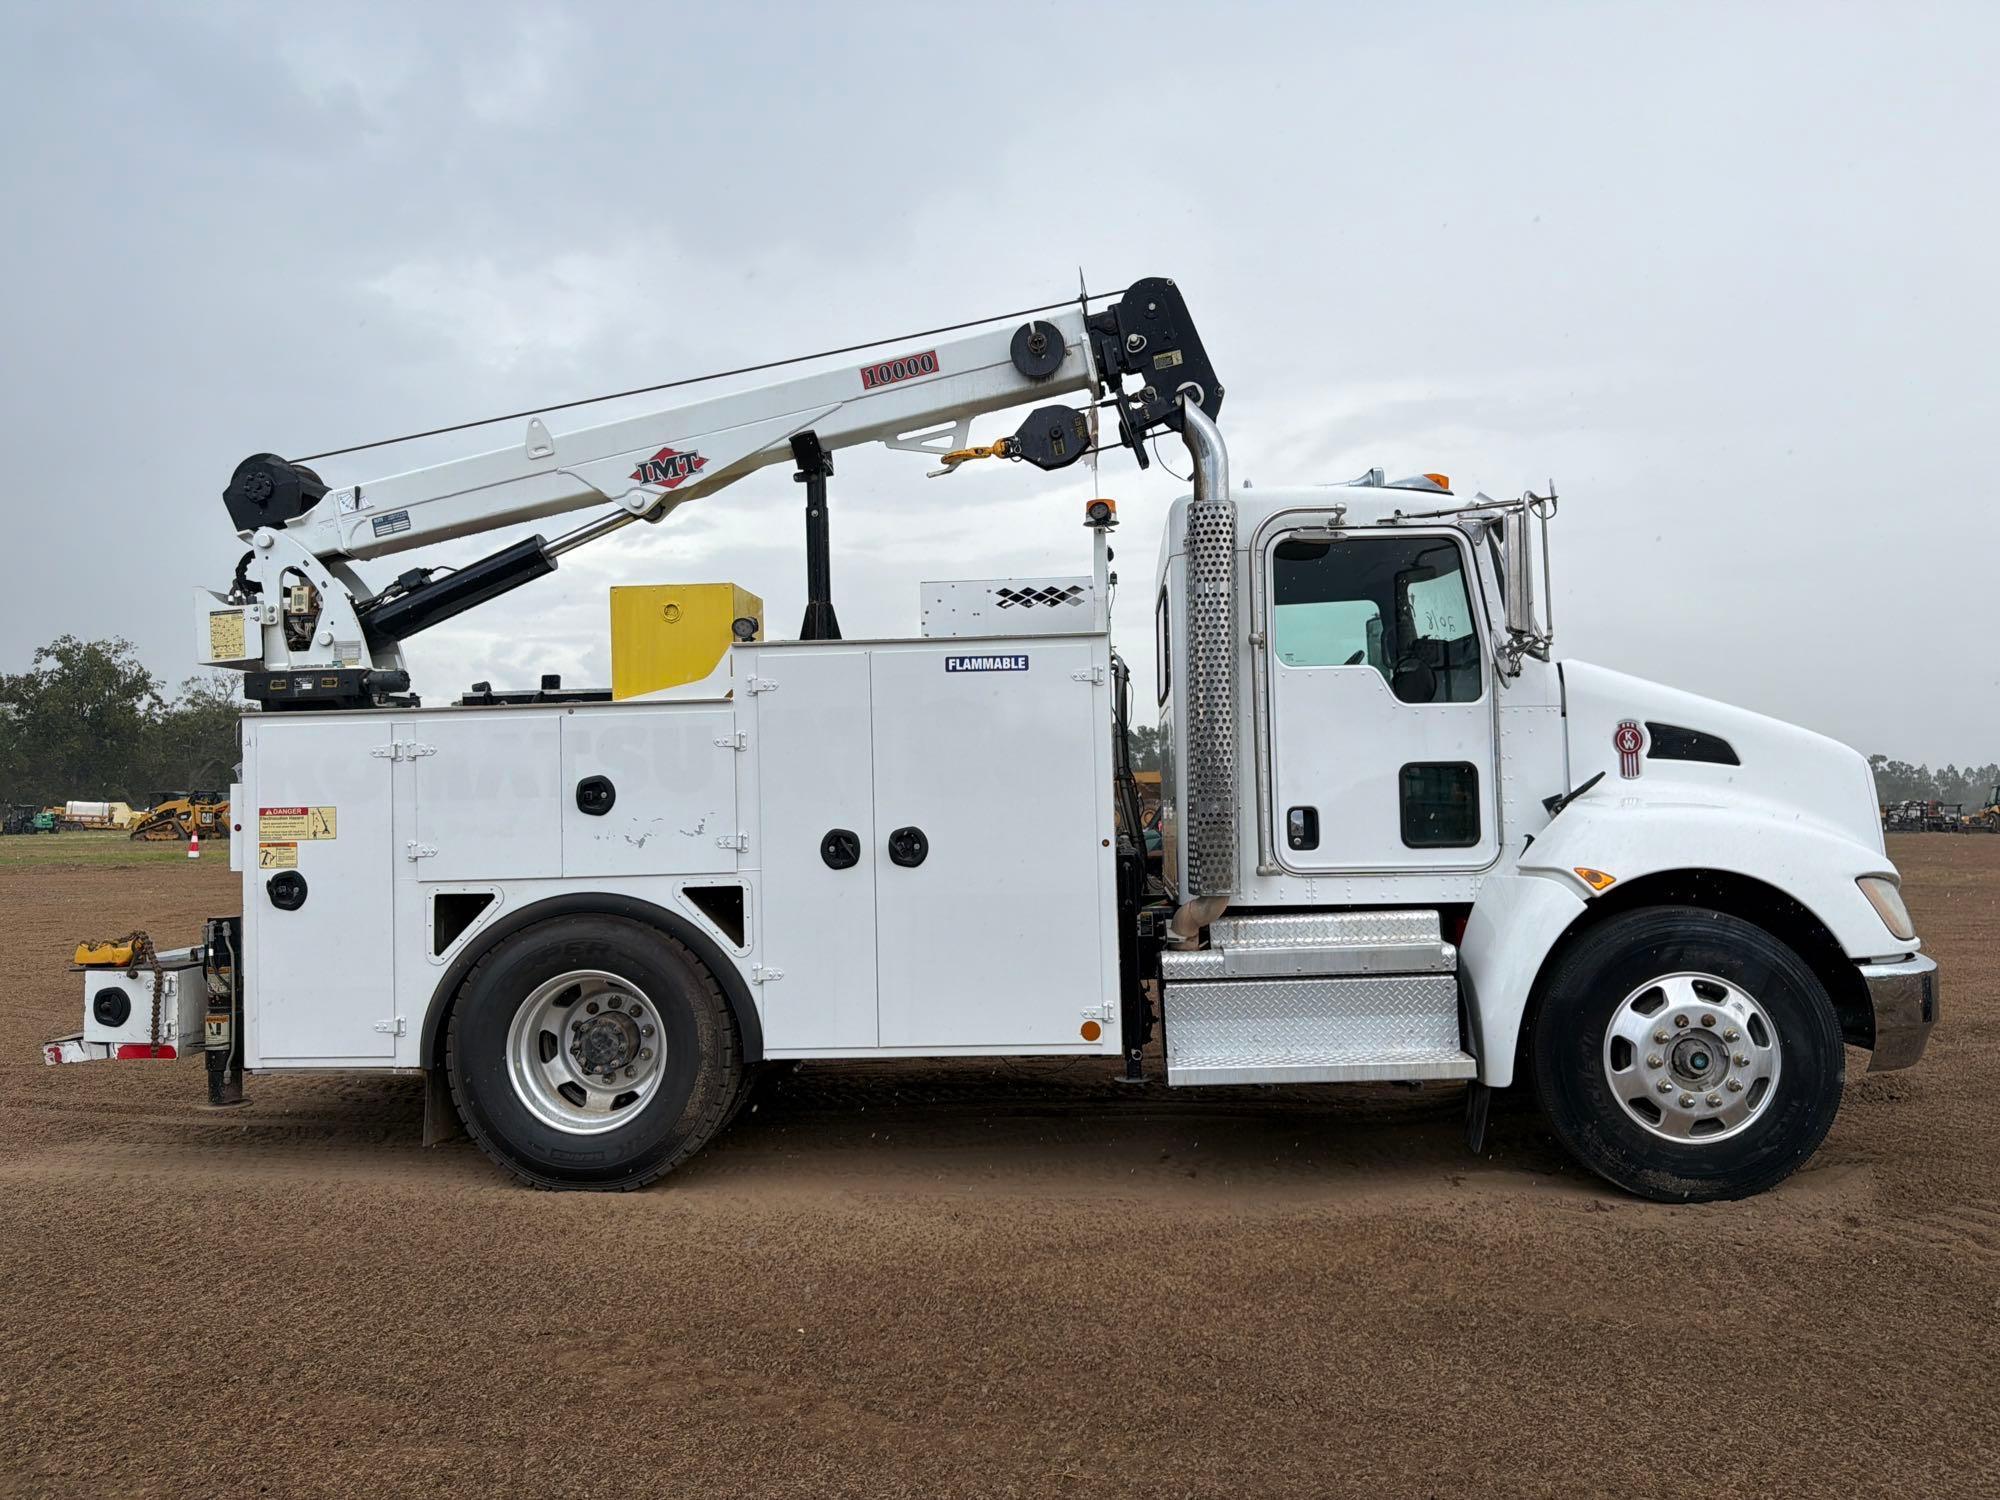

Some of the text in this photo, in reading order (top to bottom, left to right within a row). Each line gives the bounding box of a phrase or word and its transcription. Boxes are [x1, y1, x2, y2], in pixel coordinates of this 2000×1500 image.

[865, 353, 934, 388] 10000
[636, 451, 698, 486] IMT
[948, 657, 1026, 671] FLAMMABLE
